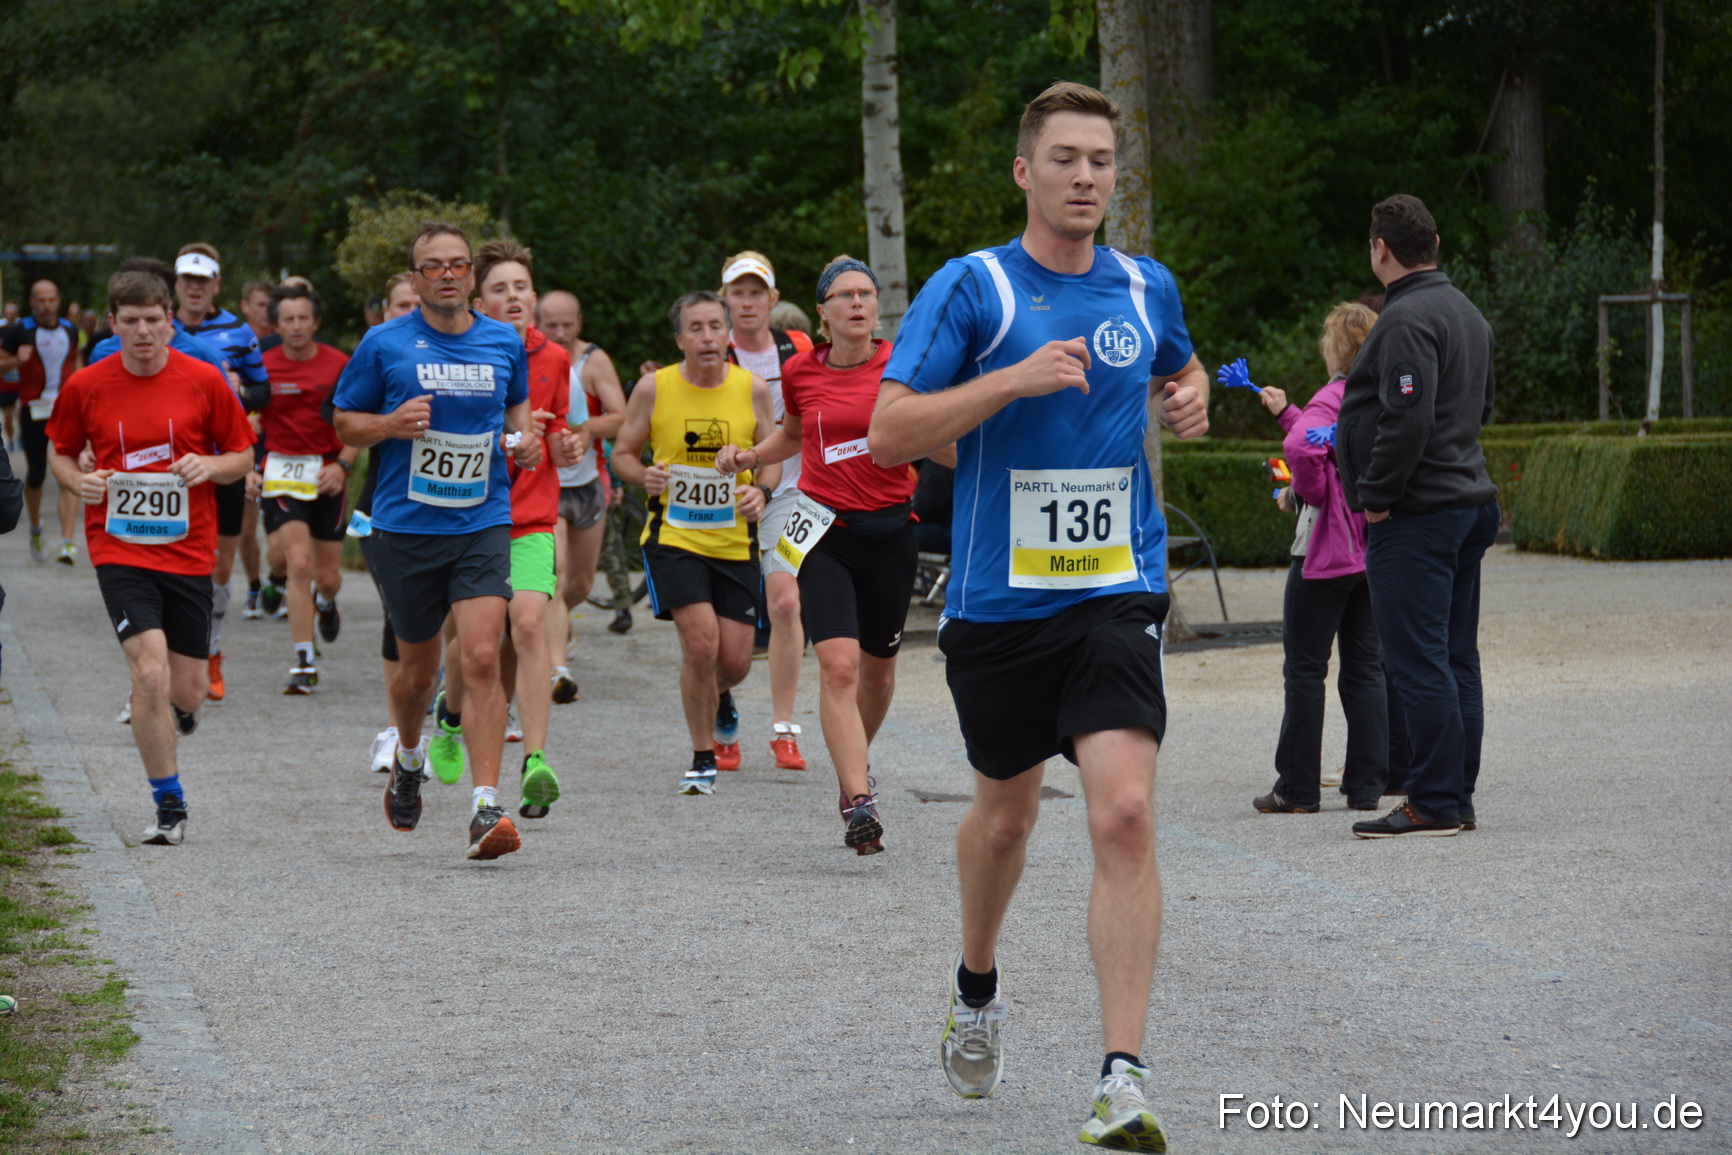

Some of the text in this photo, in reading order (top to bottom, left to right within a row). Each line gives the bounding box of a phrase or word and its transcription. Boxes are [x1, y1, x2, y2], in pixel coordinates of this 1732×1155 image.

[416, 363, 495, 382] HUBER
[436, 381, 492, 389] TECHNOLOGY
[445, 440, 482, 450] Neumarkt
[837, 444, 858, 456] DEHN
[138, 451, 158, 462] DEHN
[419, 447, 484, 479] 2672
[282, 462, 304, 479] 20
[669, 469, 692, 479] PARTL
[109, 478, 135, 487] PARTL
[1014, 481, 1115, 493] PARTL Neumarkt
[427, 482, 473, 497] Matthias
[675, 480, 730, 506] 2403
[116, 489, 181, 517] 2290
[688, 511, 714, 521] Franz
[1039, 498, 1112, 543] 136
[125, 522, 169, 535] Andreas
[783, 511, 813, 545] 36
[1016, 538, 1022, 547] C
[1050, 555, 1100, 572] Martin
